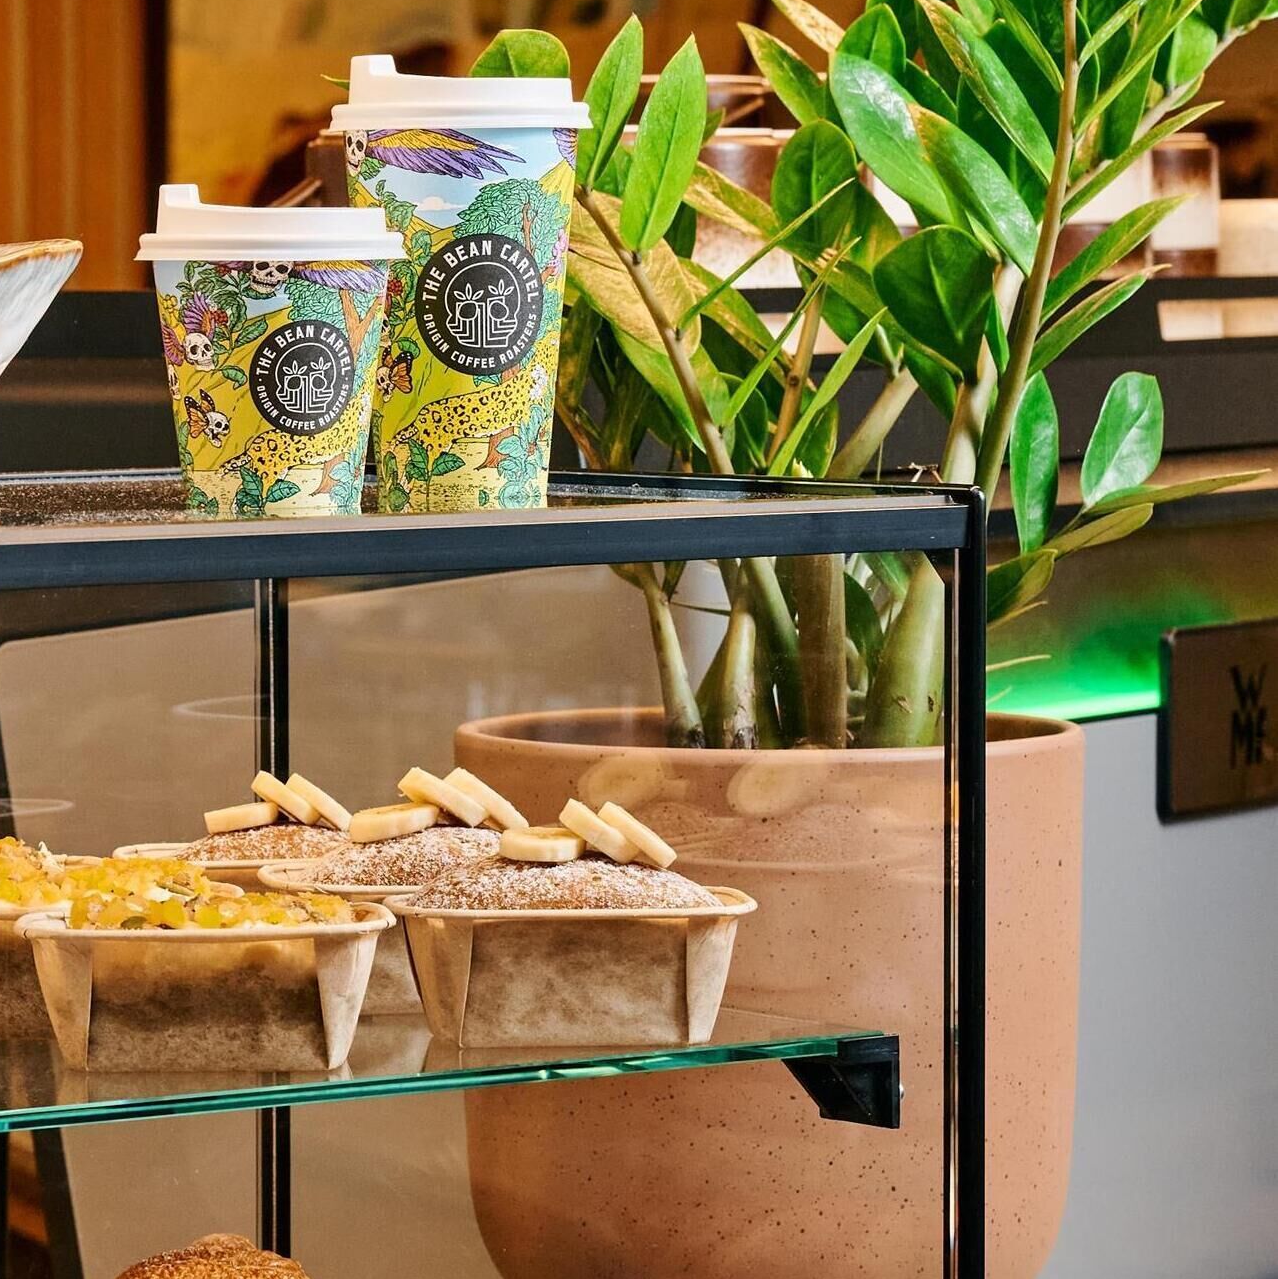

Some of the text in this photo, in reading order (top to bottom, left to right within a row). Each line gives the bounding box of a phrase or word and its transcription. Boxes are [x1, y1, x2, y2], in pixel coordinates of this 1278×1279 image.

[422, 240, 539, 302] THE BEAN CARTEL
[256, 325, 352, 376] THE BEAN CARTEL
[423, 313, 537, 369] ORIGIN COFFEE ROASTERS
[257, 384, 349, 430] ORIGIN COFFEE ROASTERS
